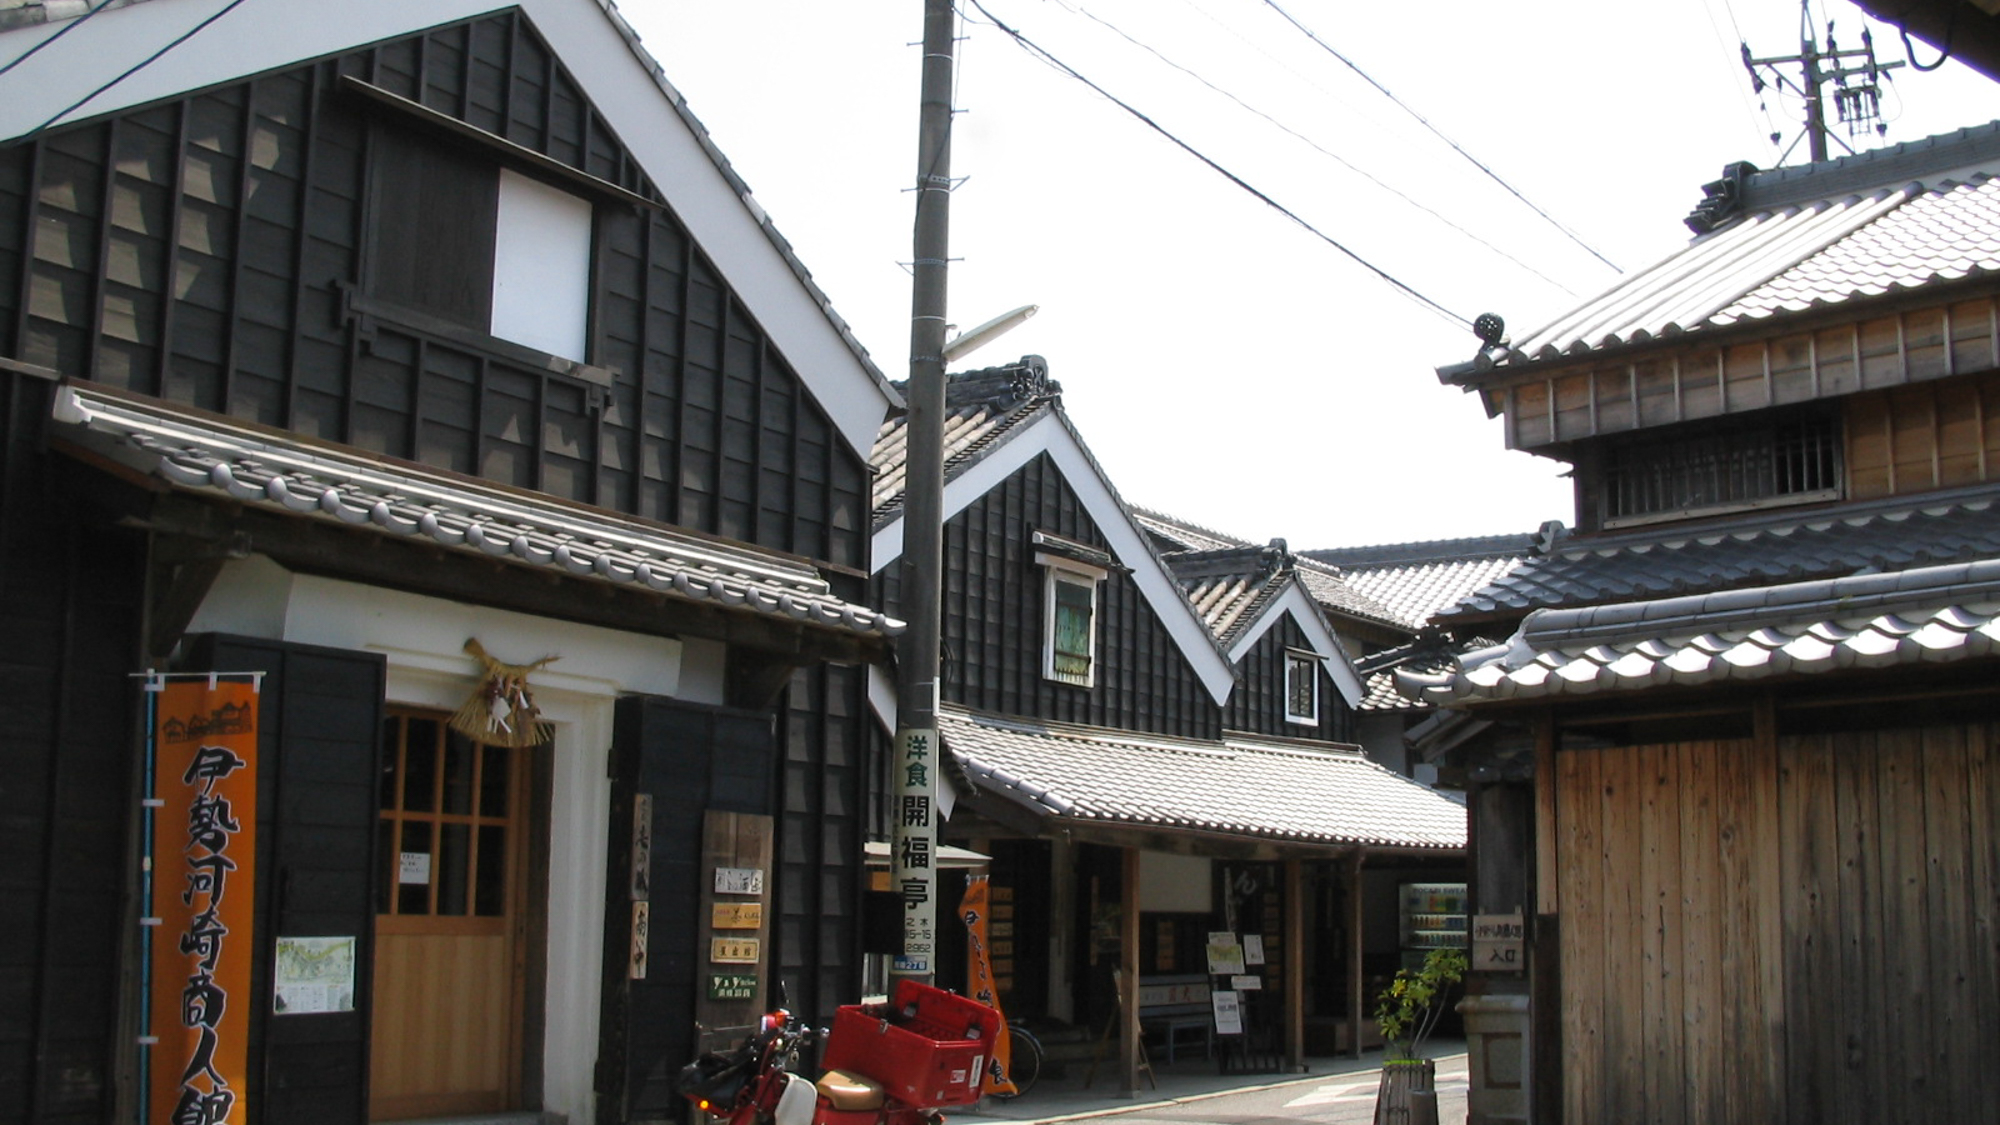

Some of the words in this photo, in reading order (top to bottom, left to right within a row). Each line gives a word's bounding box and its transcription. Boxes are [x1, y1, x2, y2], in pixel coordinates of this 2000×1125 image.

[905, 735, 929, 788] 洋食
[900, 795, 929, 910] 開福亭
